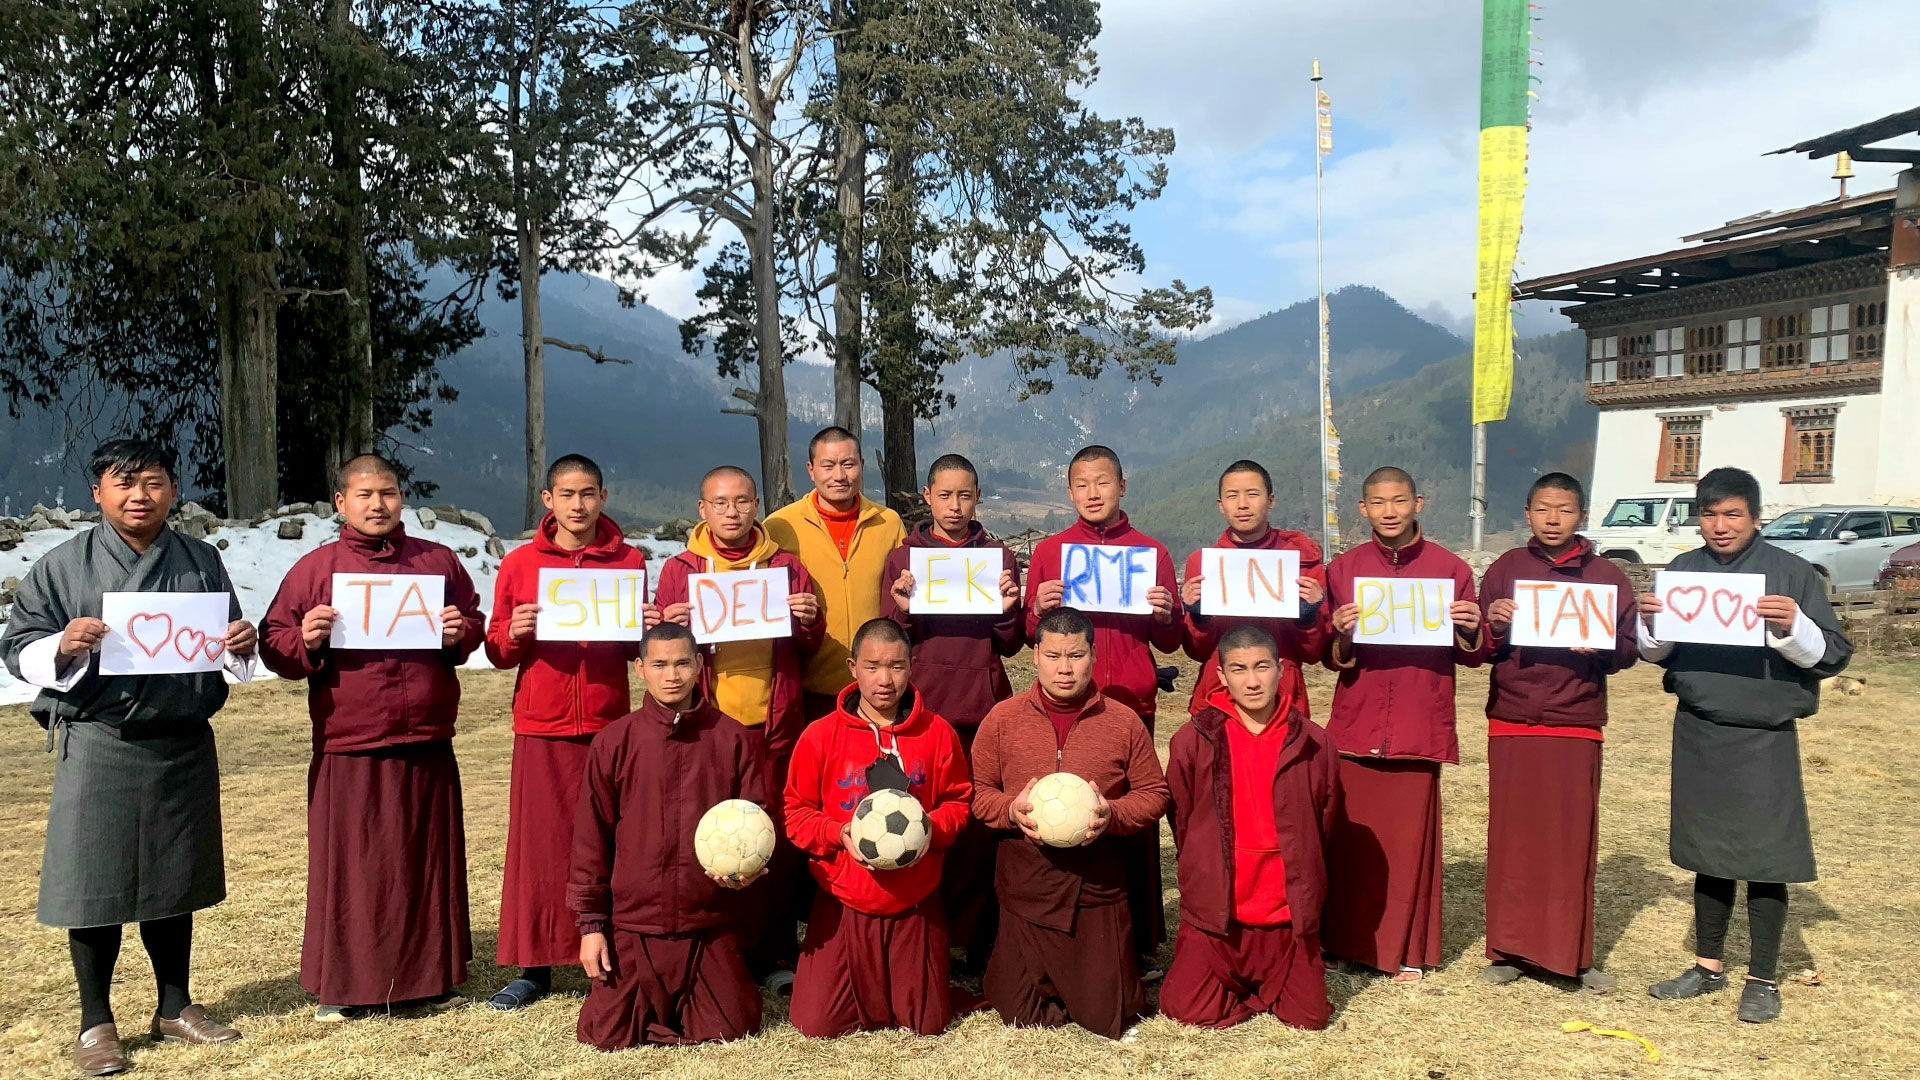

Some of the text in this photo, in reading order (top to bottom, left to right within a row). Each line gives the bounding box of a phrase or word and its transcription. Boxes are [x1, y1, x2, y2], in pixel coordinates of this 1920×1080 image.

[548, 574, 642, 627] SHI
[925, 554, 995, 604] EK
[1062, 544, 1152, 606] RMF
[1219, 557, 1283, 605] IN
[347, 580, 437, 637] TA
[696, 579, 785, 634] DEL
[1357, 580, 1445, 636] BHU
[1514, 583, 1616, 640] TAN
